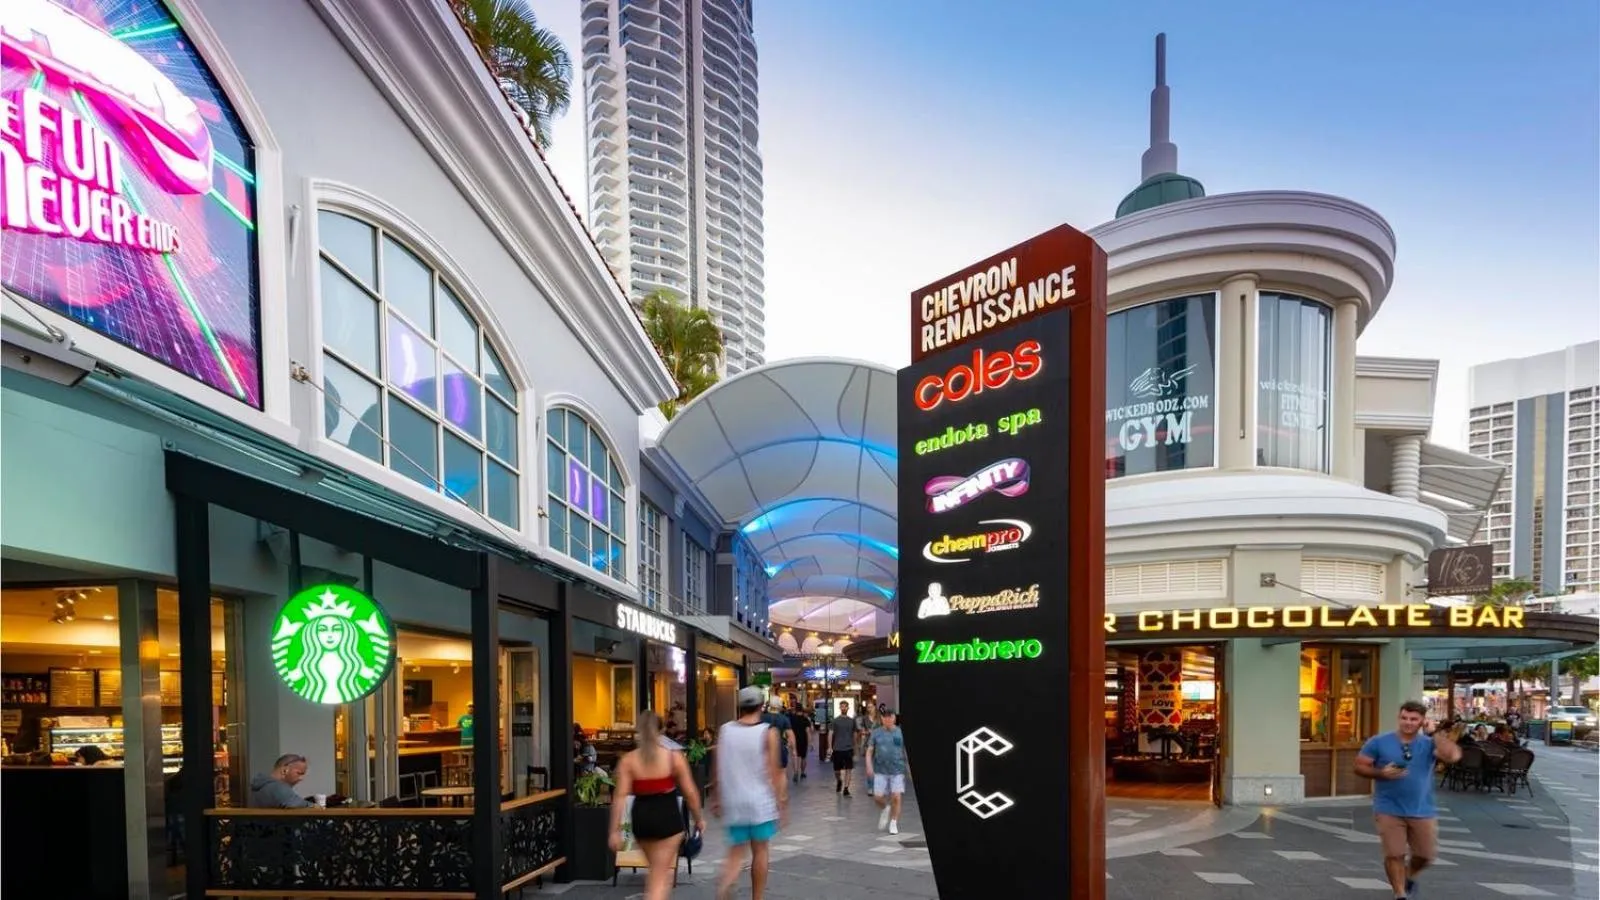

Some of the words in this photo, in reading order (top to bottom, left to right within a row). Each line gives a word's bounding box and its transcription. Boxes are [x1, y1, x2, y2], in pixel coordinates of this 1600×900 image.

[23, 88, 122, 194] FUN
[921, 257, 1018, 322] CHEVRON
[921, 265, 1076, 352] RENAISSANCE
[913, 339, 1043, 411] coles
[915, 423, 990, 455] endota
[998, 408, 1042, 435] spa
[1119, 411, 1194, 451] GYM
[931, 460, 1020, 513] INFINITY
[932, 527, 1021, 556] chempro
[949, 584, 1040, 614] PappaRich
[1138, 604, 1432, 632] CHOCOLATE
[1450, 604, 1525, 629] BAR
[616, 603, 676, 644] STARBUCKS
[915, 637, 1043, 663] Zambrero
